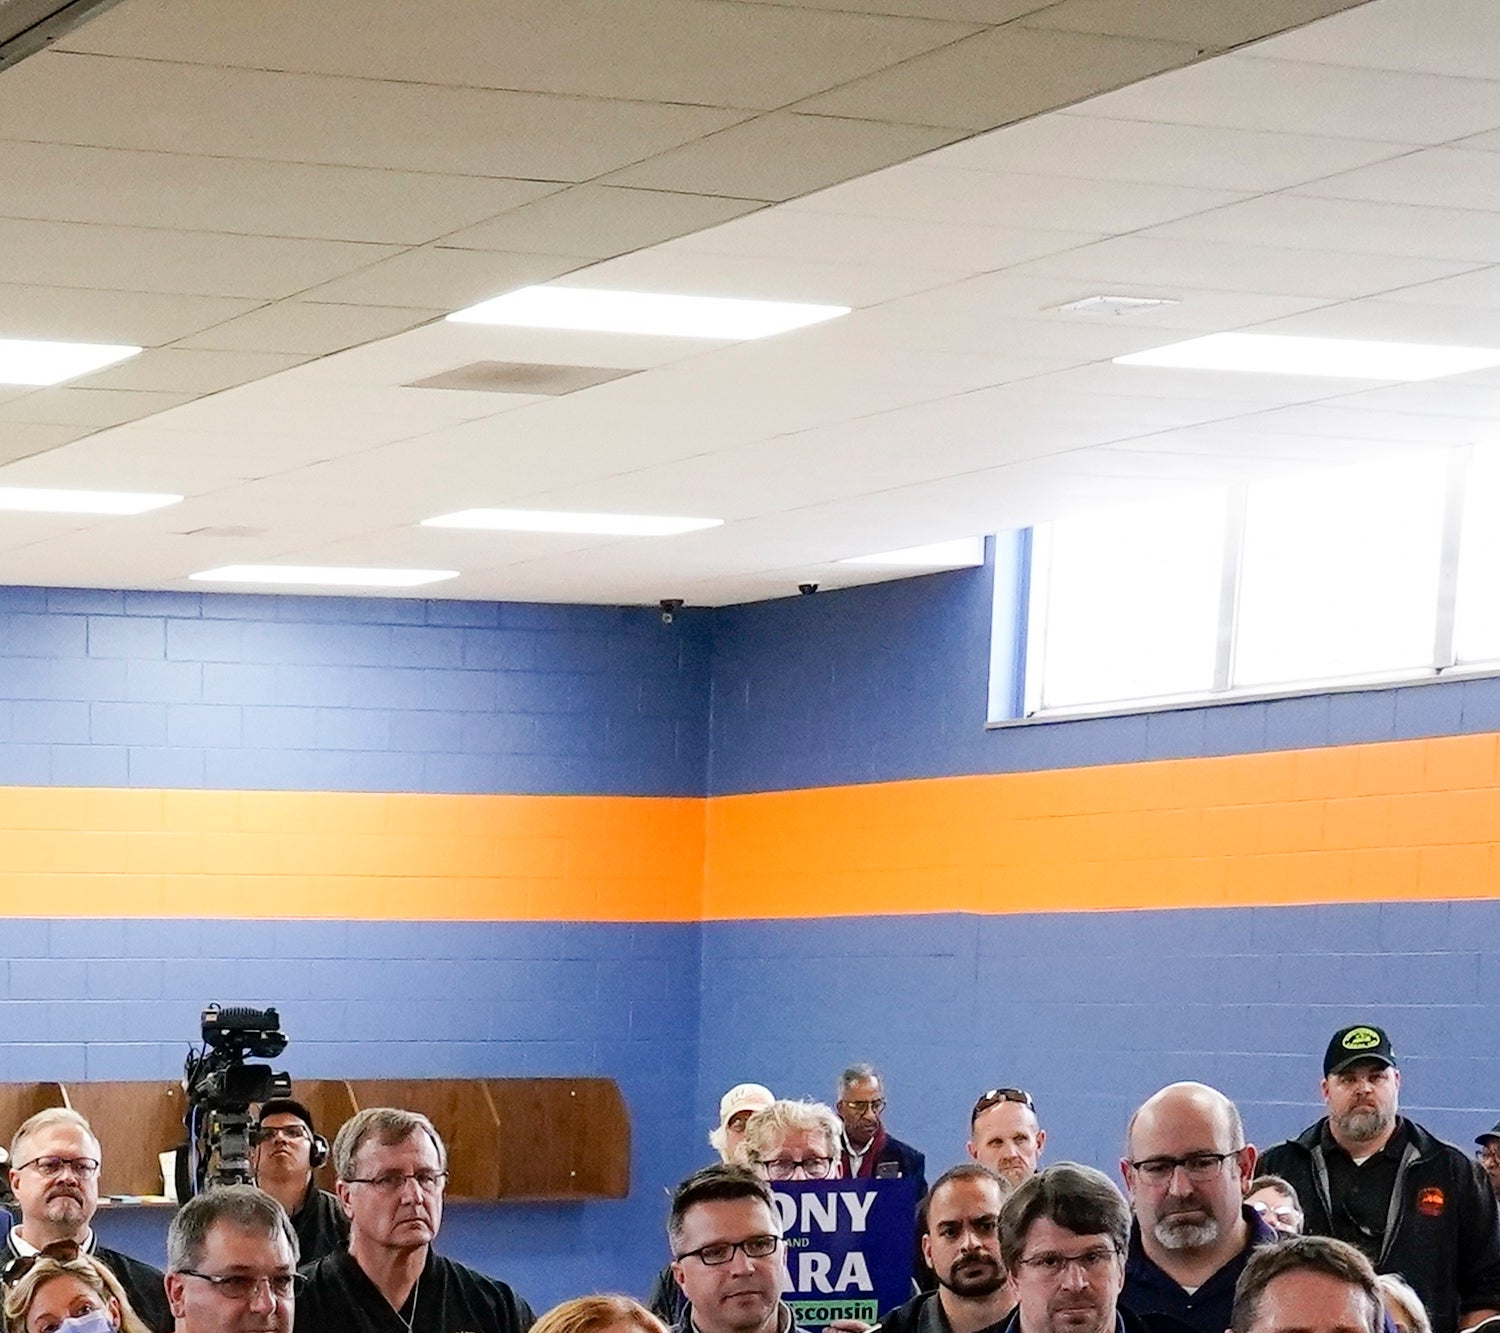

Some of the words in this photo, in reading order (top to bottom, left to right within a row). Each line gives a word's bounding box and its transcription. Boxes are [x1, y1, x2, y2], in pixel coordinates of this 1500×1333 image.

[773, 1191, 878, 1233] ONY
[780, 1251, 874, 1293] RA
[791, 1302, 873, 1321] sconsin
